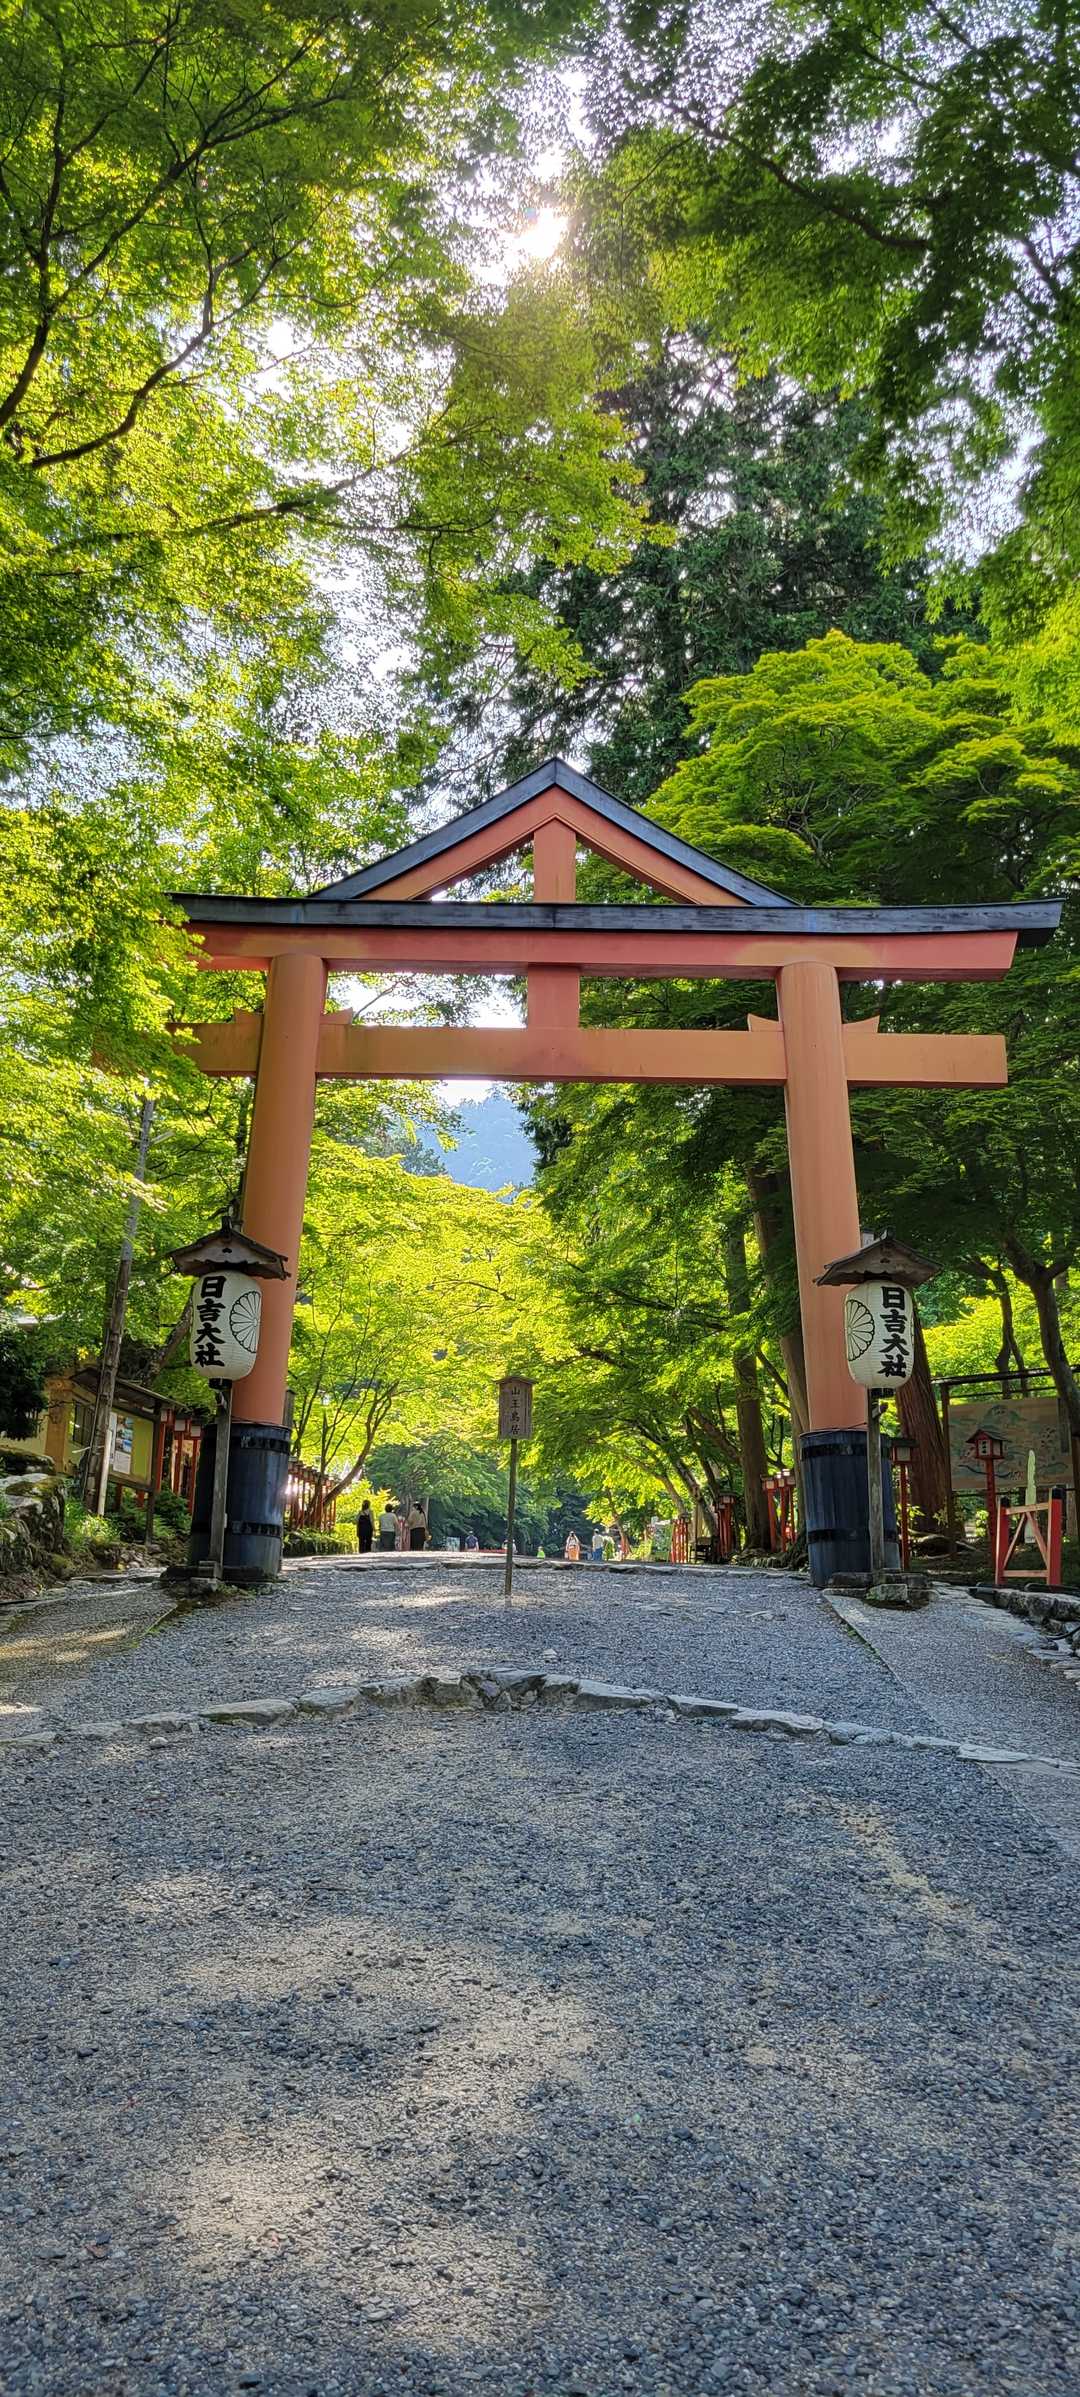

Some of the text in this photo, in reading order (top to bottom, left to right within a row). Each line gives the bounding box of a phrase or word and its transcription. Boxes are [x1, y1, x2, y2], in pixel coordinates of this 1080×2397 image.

[193, 1275, 227, 1368] 日吉大社
[877, 1286, 910, 1378] 日吉大社
